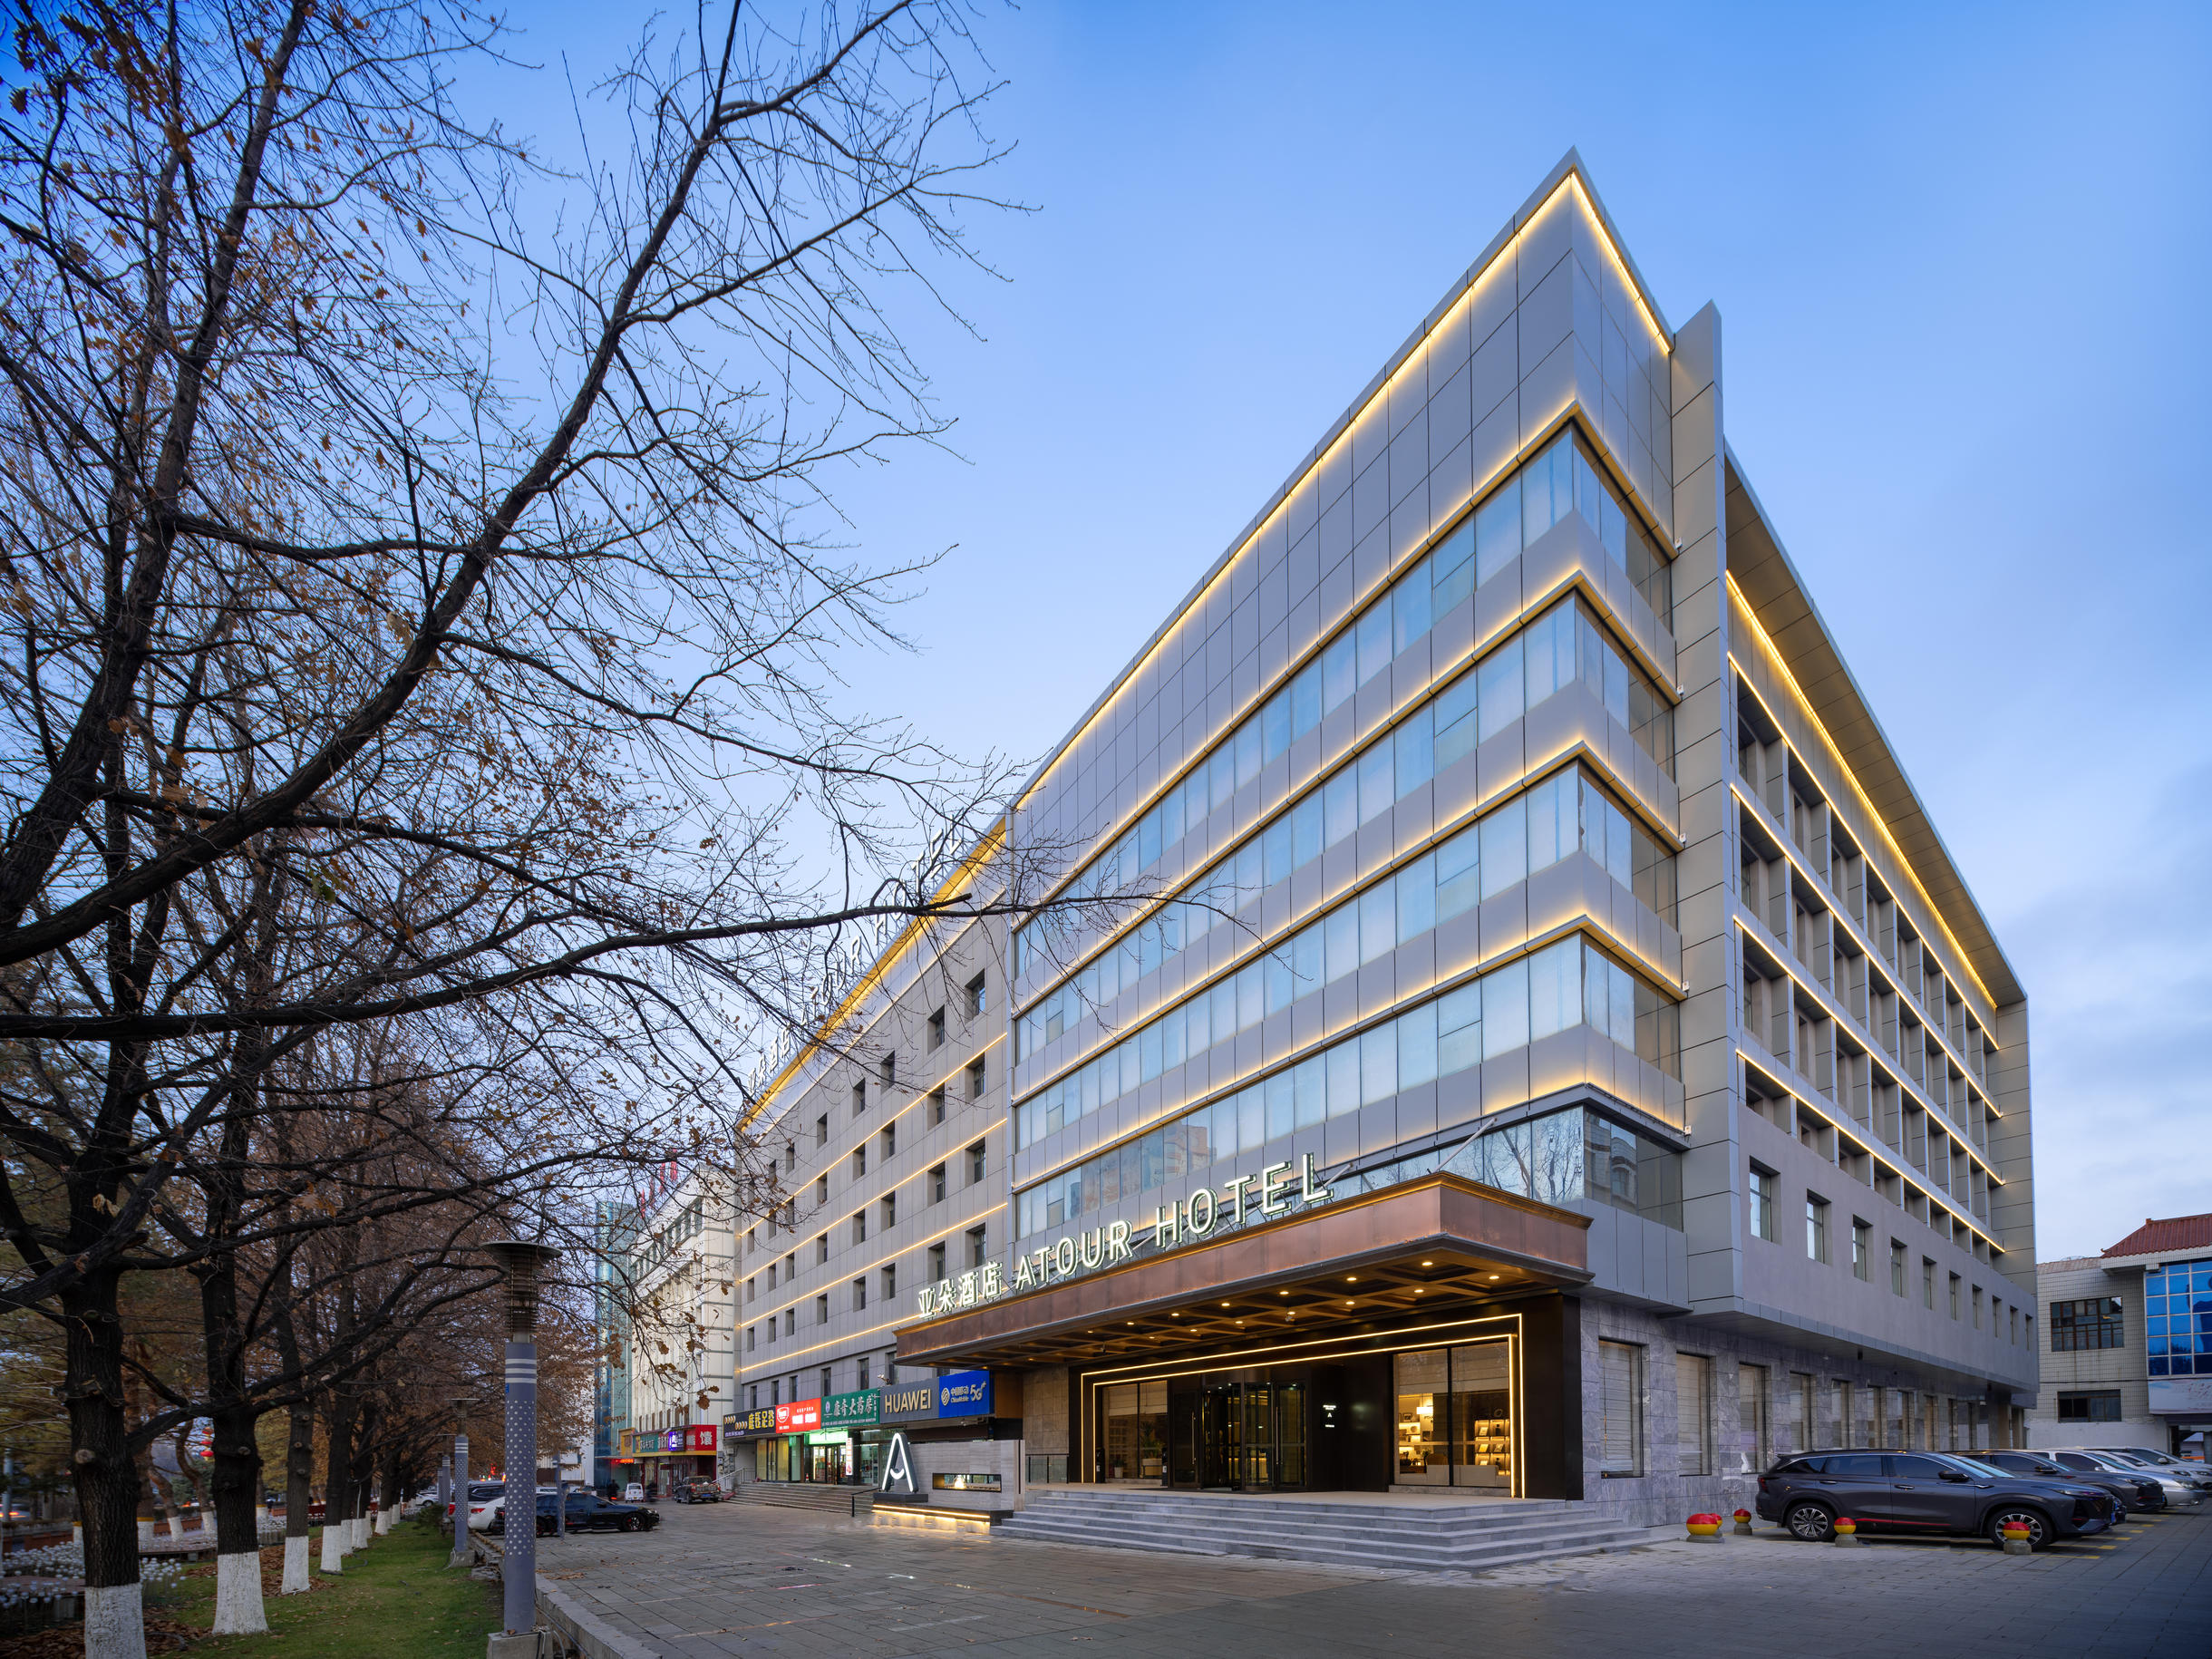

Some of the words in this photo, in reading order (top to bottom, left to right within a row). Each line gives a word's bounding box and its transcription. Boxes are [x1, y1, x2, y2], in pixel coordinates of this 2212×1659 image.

[917, 1261, 1003, 1319] 亚朵酒店
[1015, 1218, 1133, 1291] ATOUR
[1156, 1152, 1334, 1249] HOTEL
[885, 1388, 931, 1413] HUAWEI
